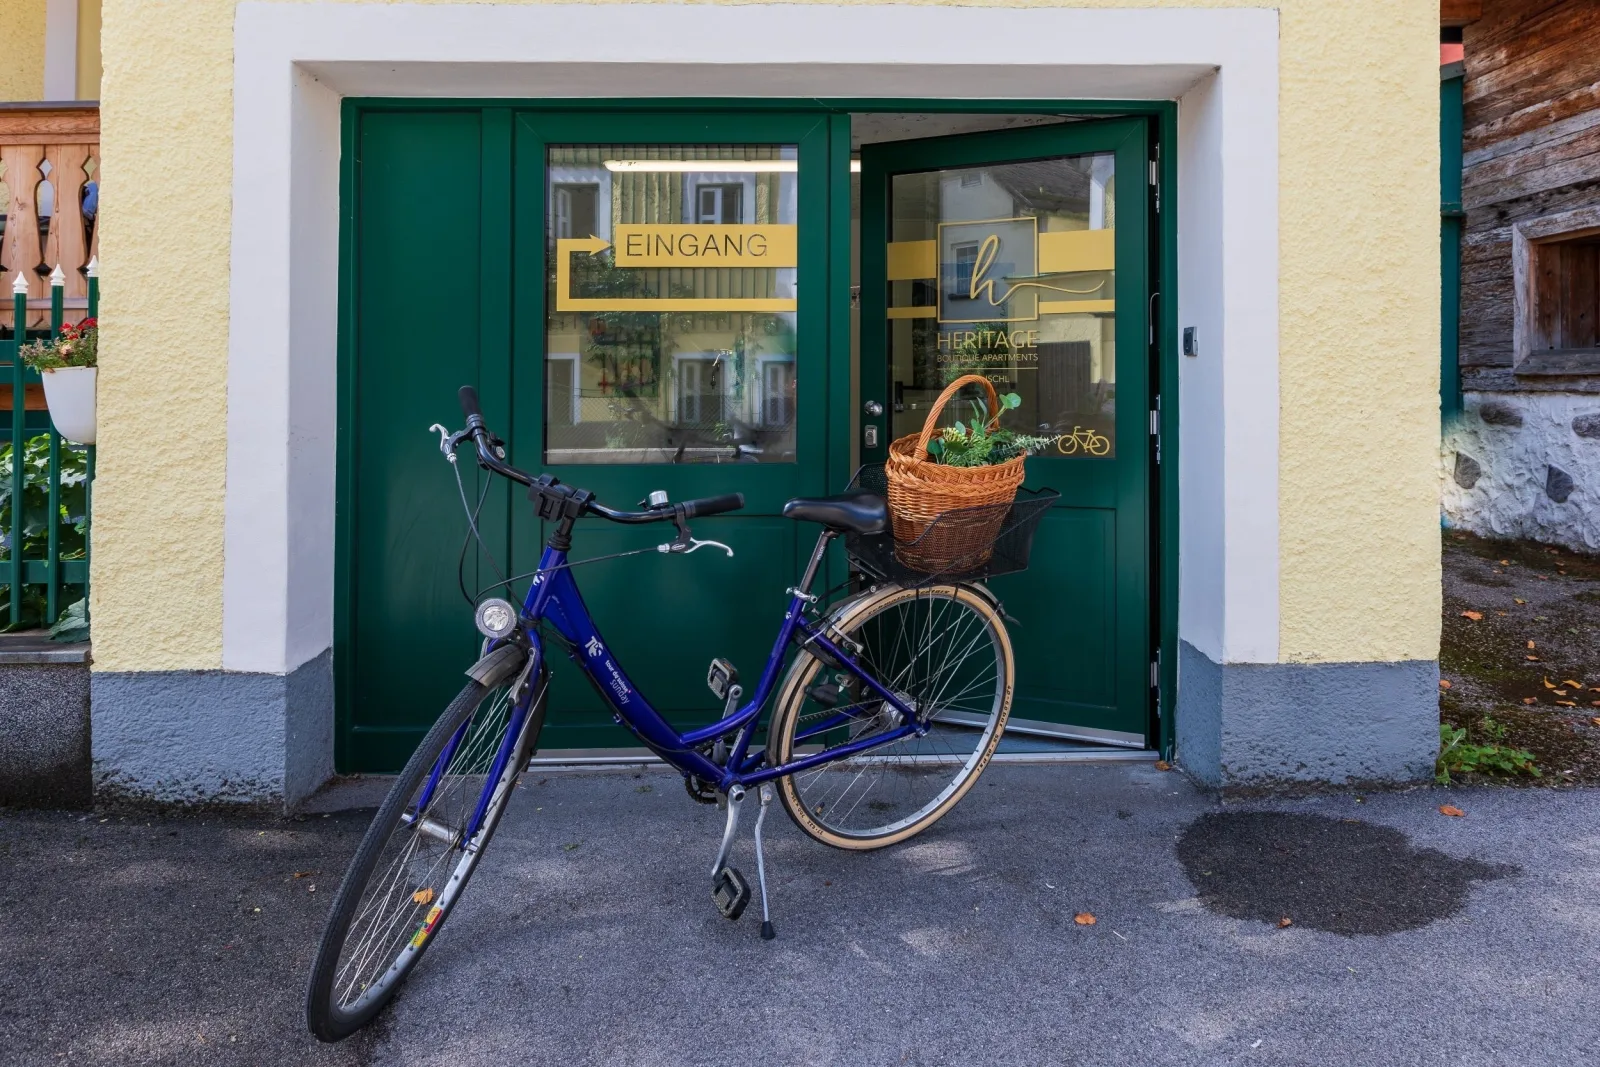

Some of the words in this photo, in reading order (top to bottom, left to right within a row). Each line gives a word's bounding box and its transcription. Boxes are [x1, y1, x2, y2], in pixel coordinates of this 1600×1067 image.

[626, 233, 768, 257] EINGANG
[937, 330, 1038, 350] HERITAGE
[936, 353, 980, 363] BOUTIQUE
[981, 352, 1039, 362] APARTMENTS
[610, 679, 631, 704] sunday
